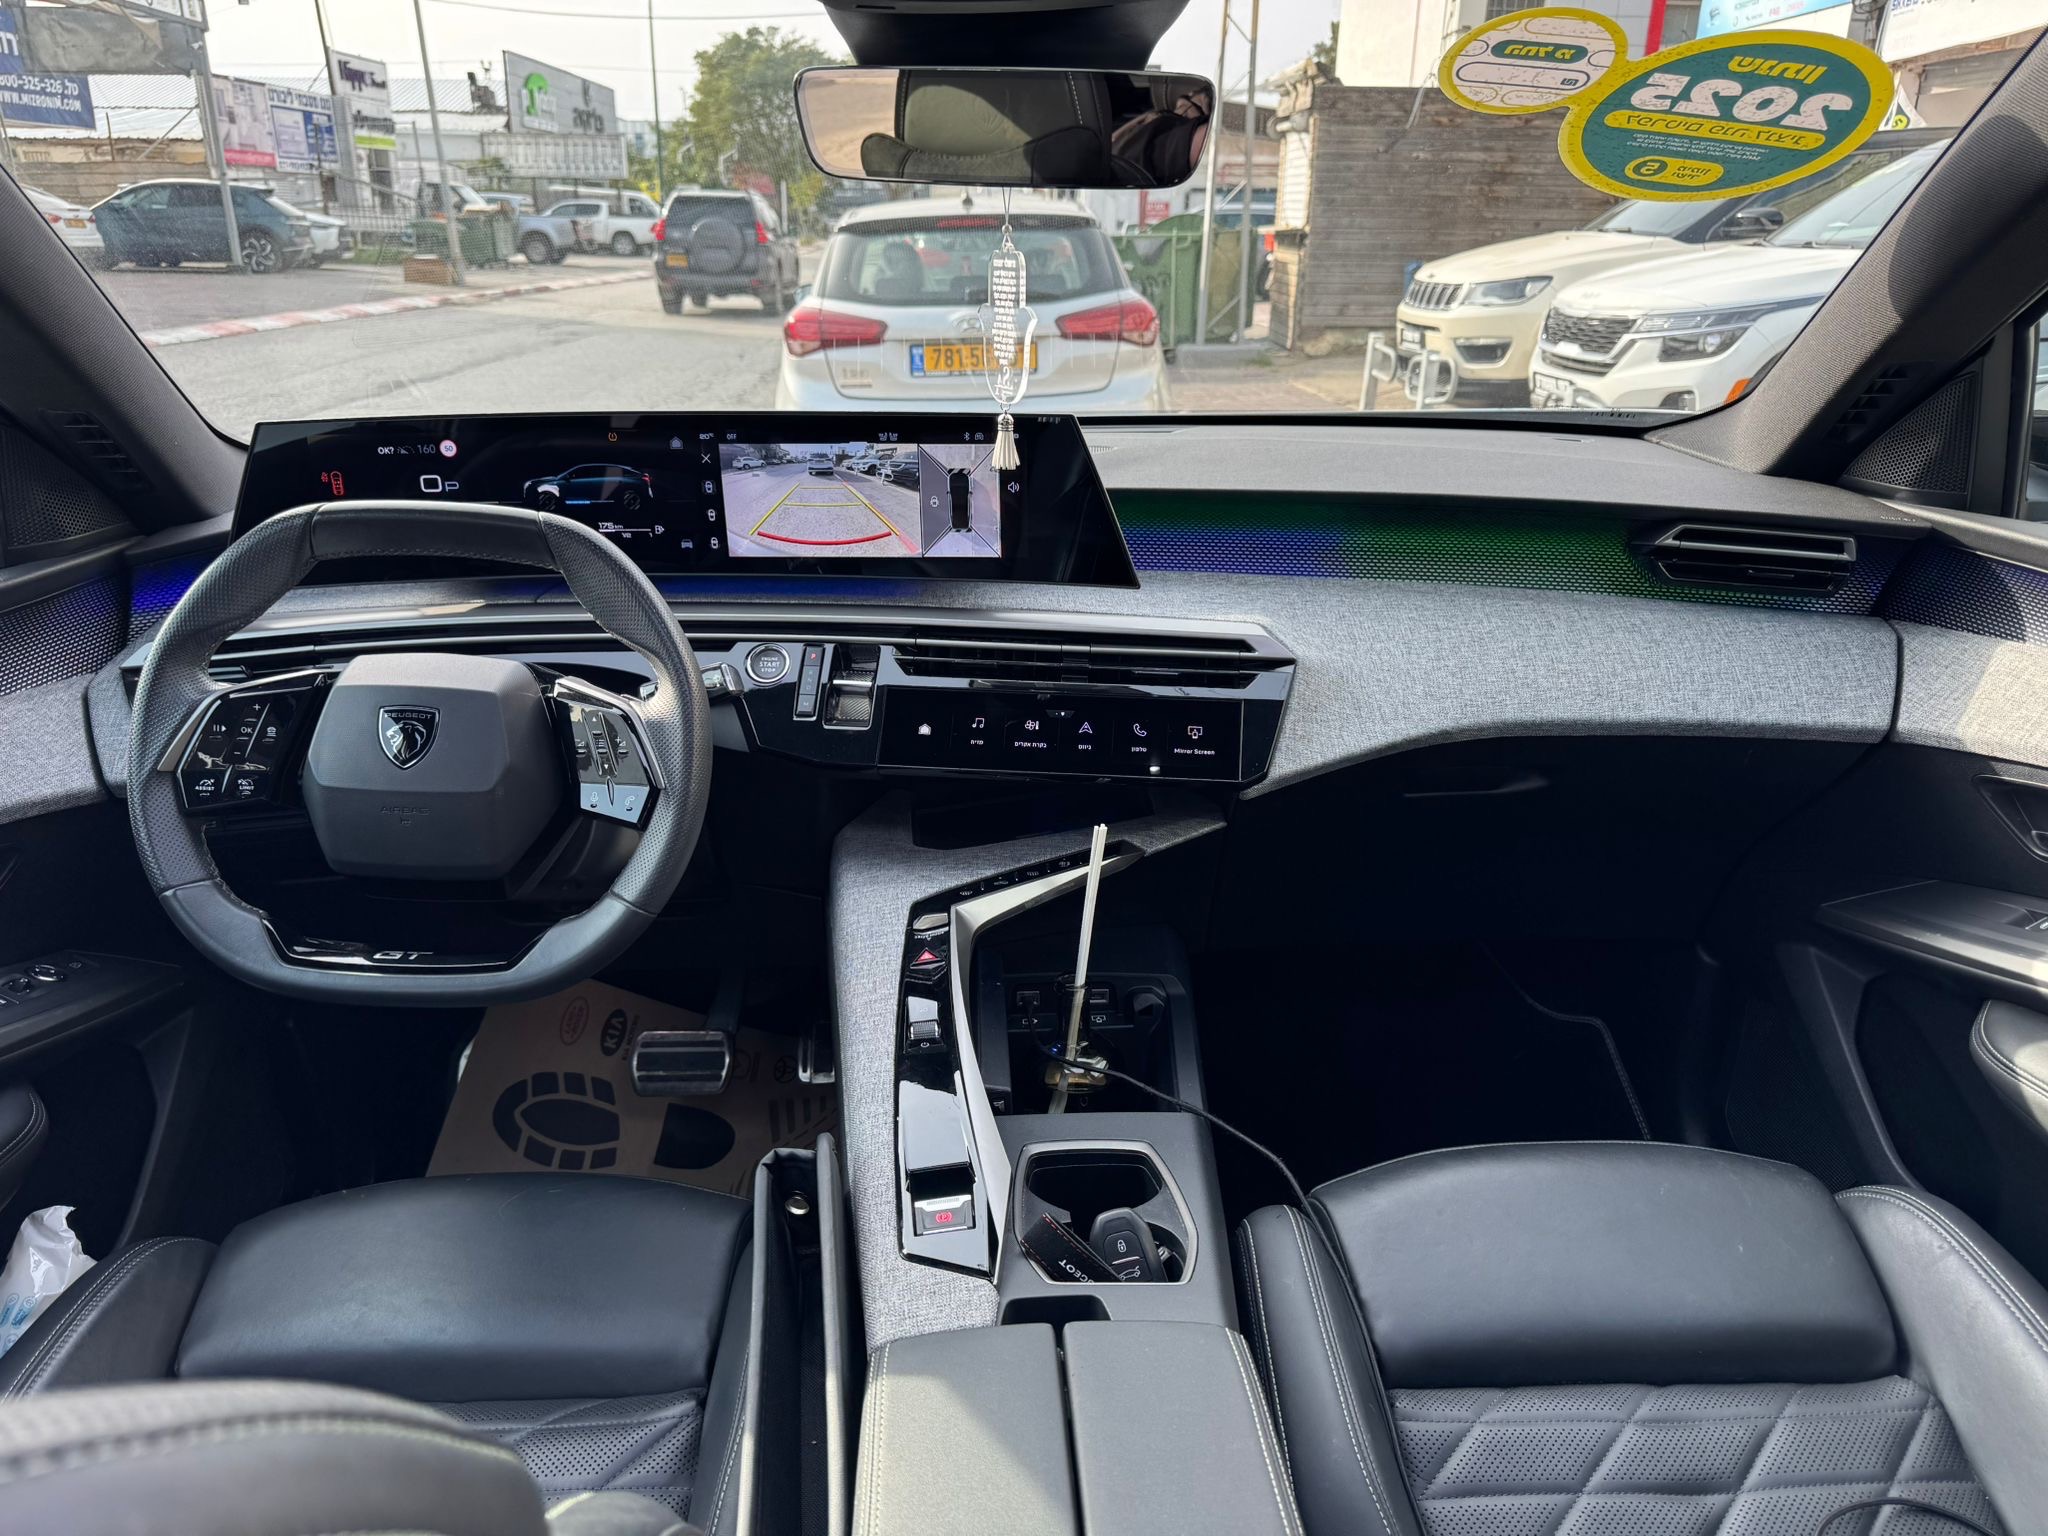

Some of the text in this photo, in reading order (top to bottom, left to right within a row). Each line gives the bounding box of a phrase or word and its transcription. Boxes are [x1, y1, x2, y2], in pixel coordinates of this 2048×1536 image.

[377, 444, 436, 455] OK? 160
[598, 522, 614, 530] 175
[384, 712, 432, 720] PEUGEOT
[240, 726, 254, 734] OK
[373, 950, 434, 960] GT
[603, 1017, 625, 1049] KIA
